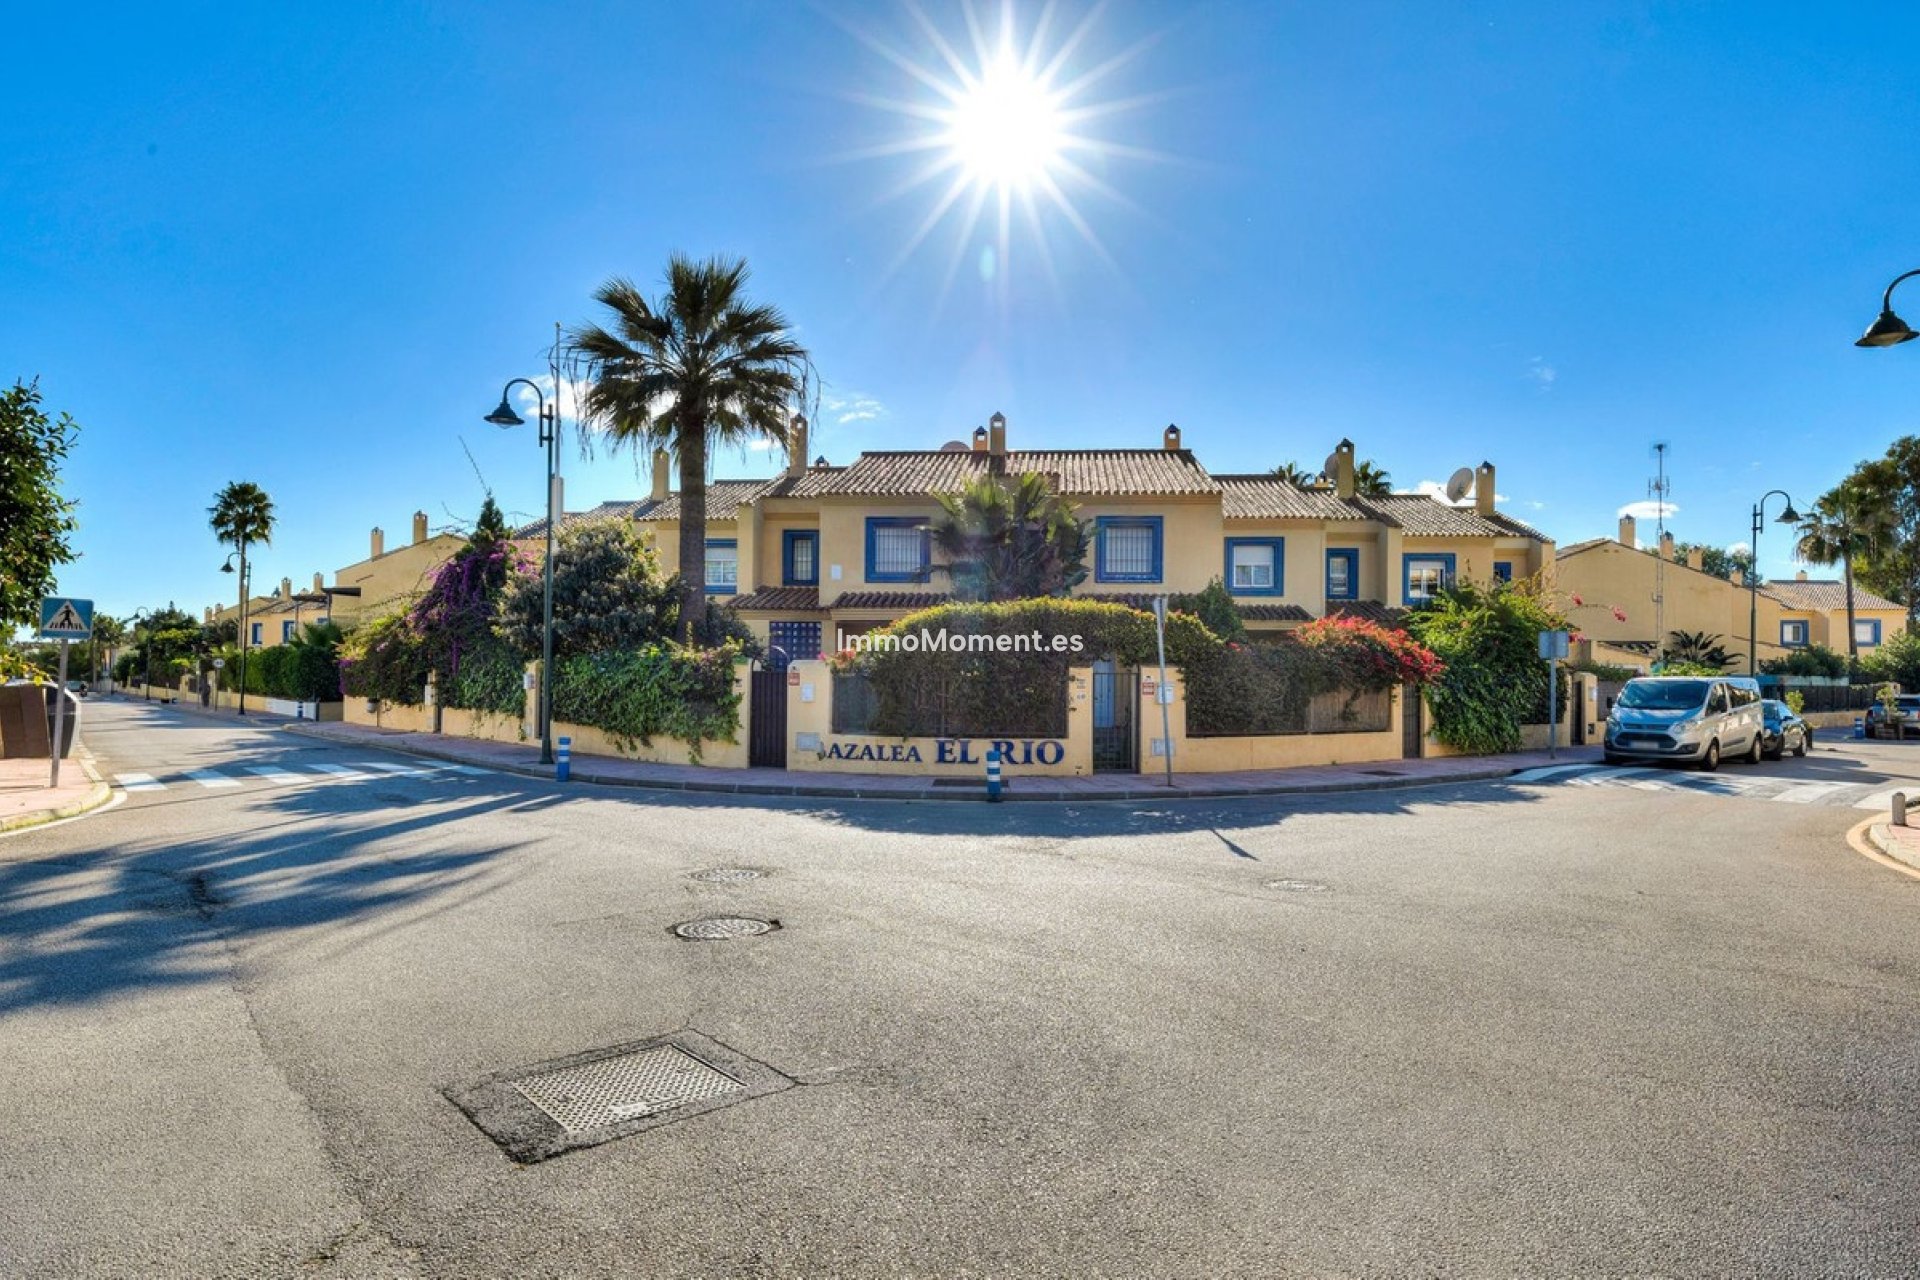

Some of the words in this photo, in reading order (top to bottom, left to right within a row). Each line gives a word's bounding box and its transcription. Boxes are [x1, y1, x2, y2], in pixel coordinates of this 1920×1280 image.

[827, 742, 923, 763] AZALEA
[934, 738, 979, 765] EL
[990, 738, 1065, 765] RIO
